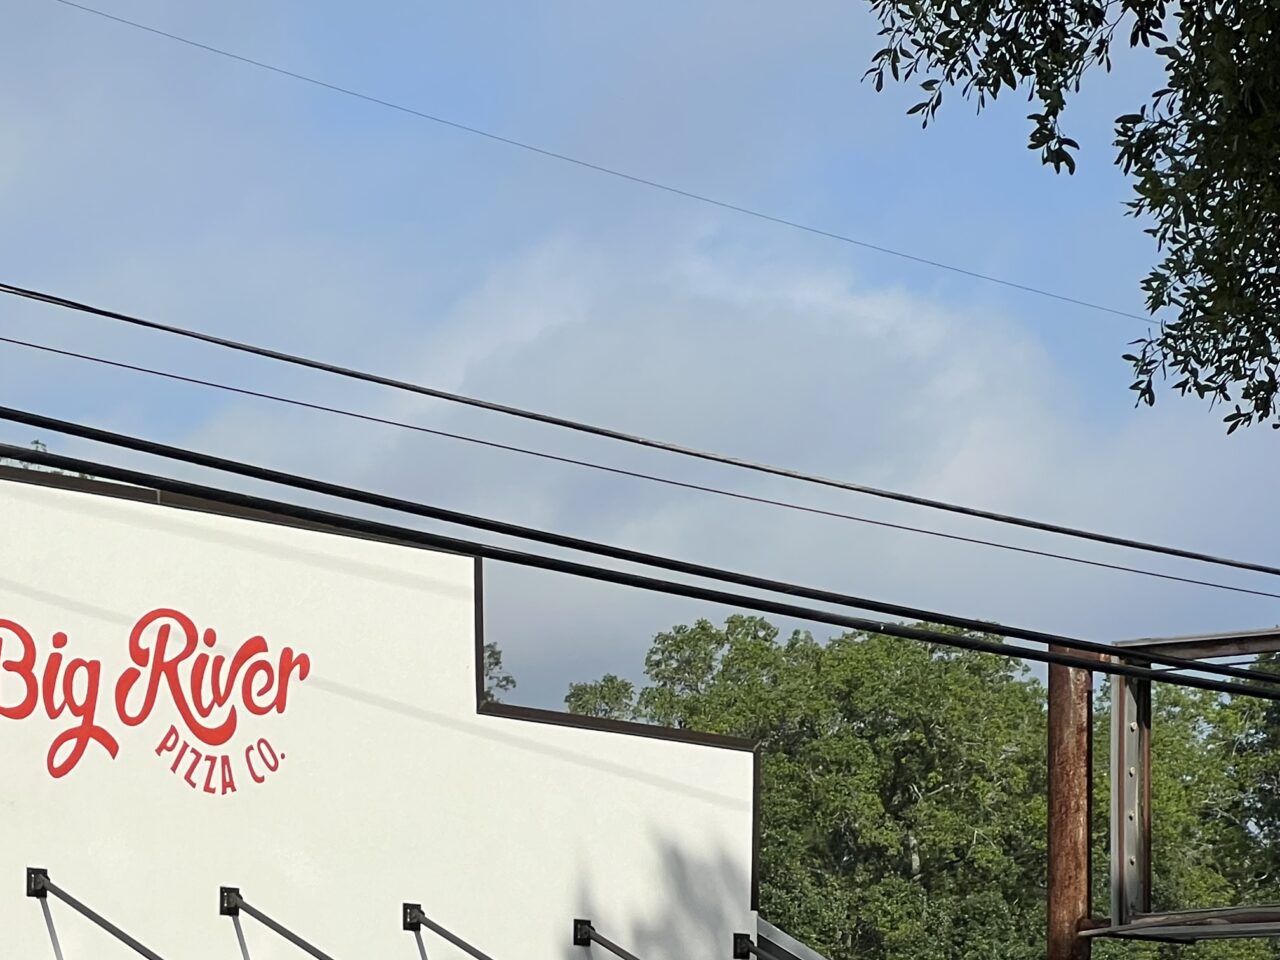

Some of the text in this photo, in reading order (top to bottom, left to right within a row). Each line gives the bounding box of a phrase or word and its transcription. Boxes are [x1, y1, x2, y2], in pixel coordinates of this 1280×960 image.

[115, 608, 310, 745] River
[155, 724, 286, 795] PIZZA CO.
